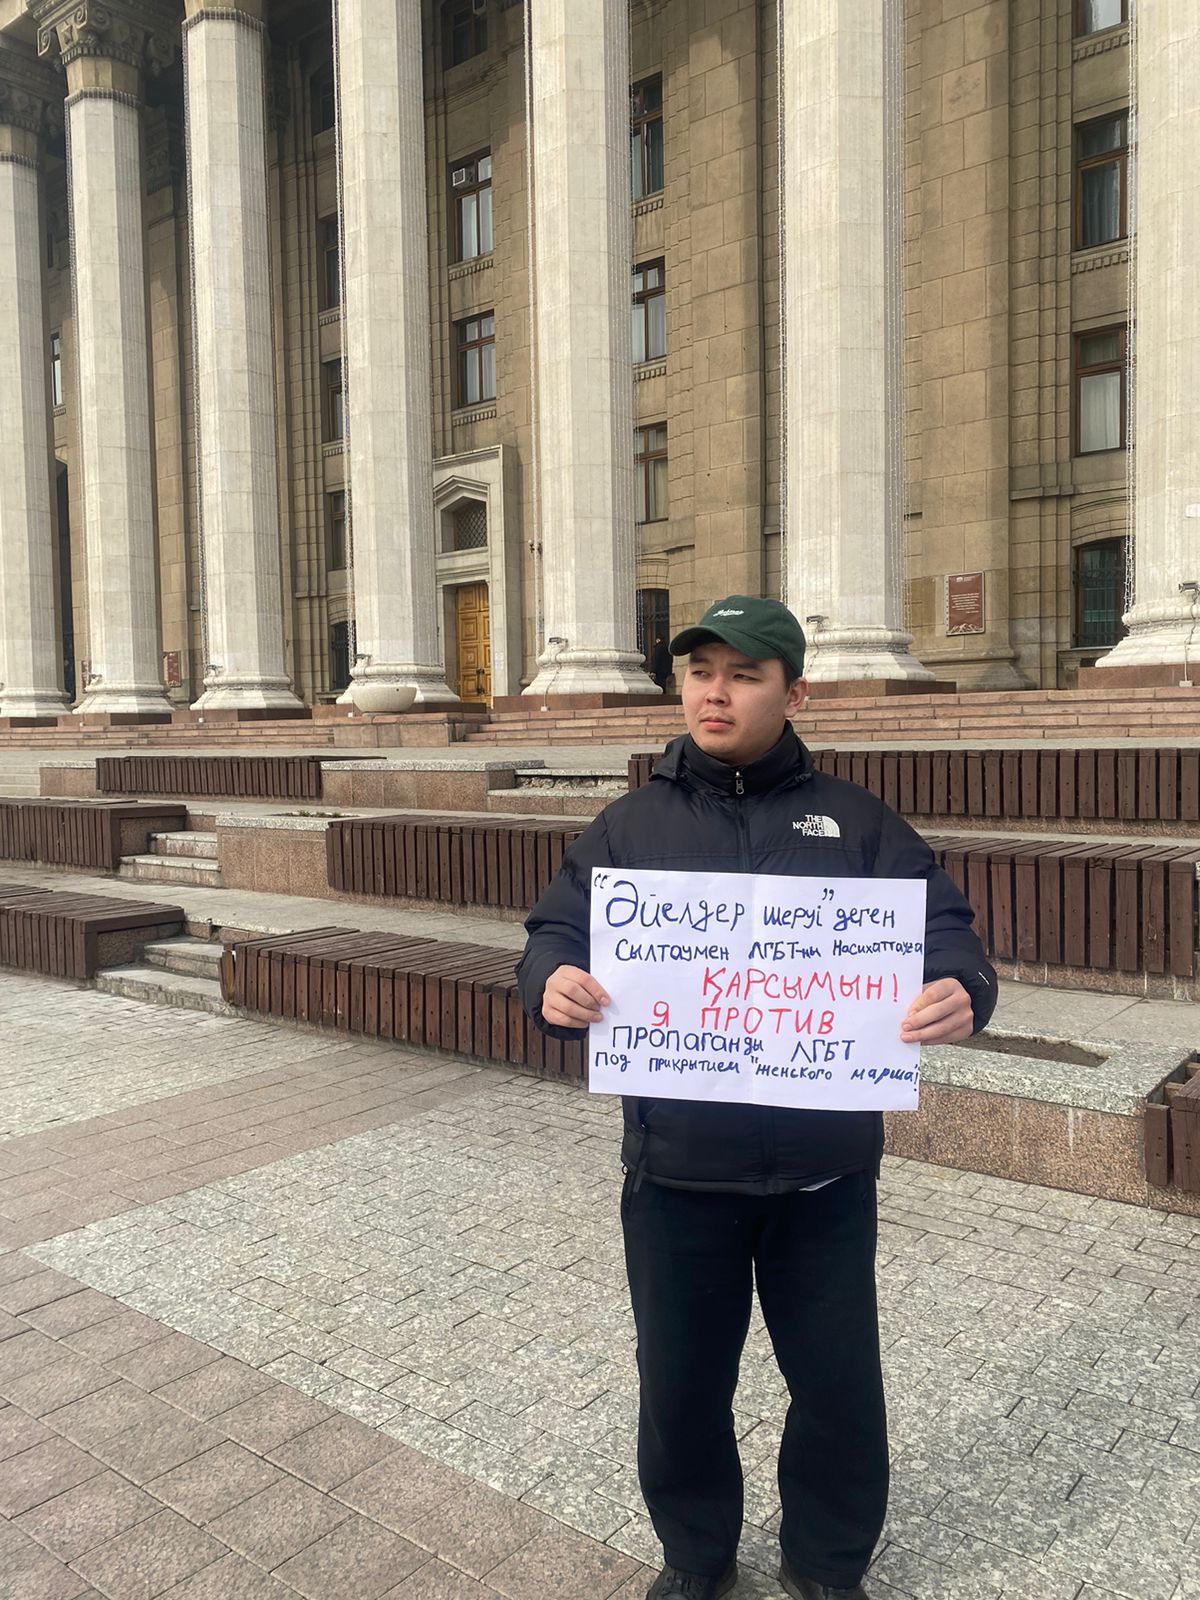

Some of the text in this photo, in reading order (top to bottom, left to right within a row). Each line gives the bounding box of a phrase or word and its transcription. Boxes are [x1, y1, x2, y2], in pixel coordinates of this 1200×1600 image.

[792, 821, 824, 830] NORTH
[804, 814, 823, 822] THE
[802, 829, 825, 837] FACE
[832, 907, 896, 932] деген
[748, 941, 822, 961] ЛГБТ-ны
[702, 966, 898, 1007] ҚАРСЫМЫН!
[651, 1000, 835, 1035] Я ПРОТИВ
[790, 1038, 856, 1063] ЛГБТ
[594, 1051, 632, 1073] Под
